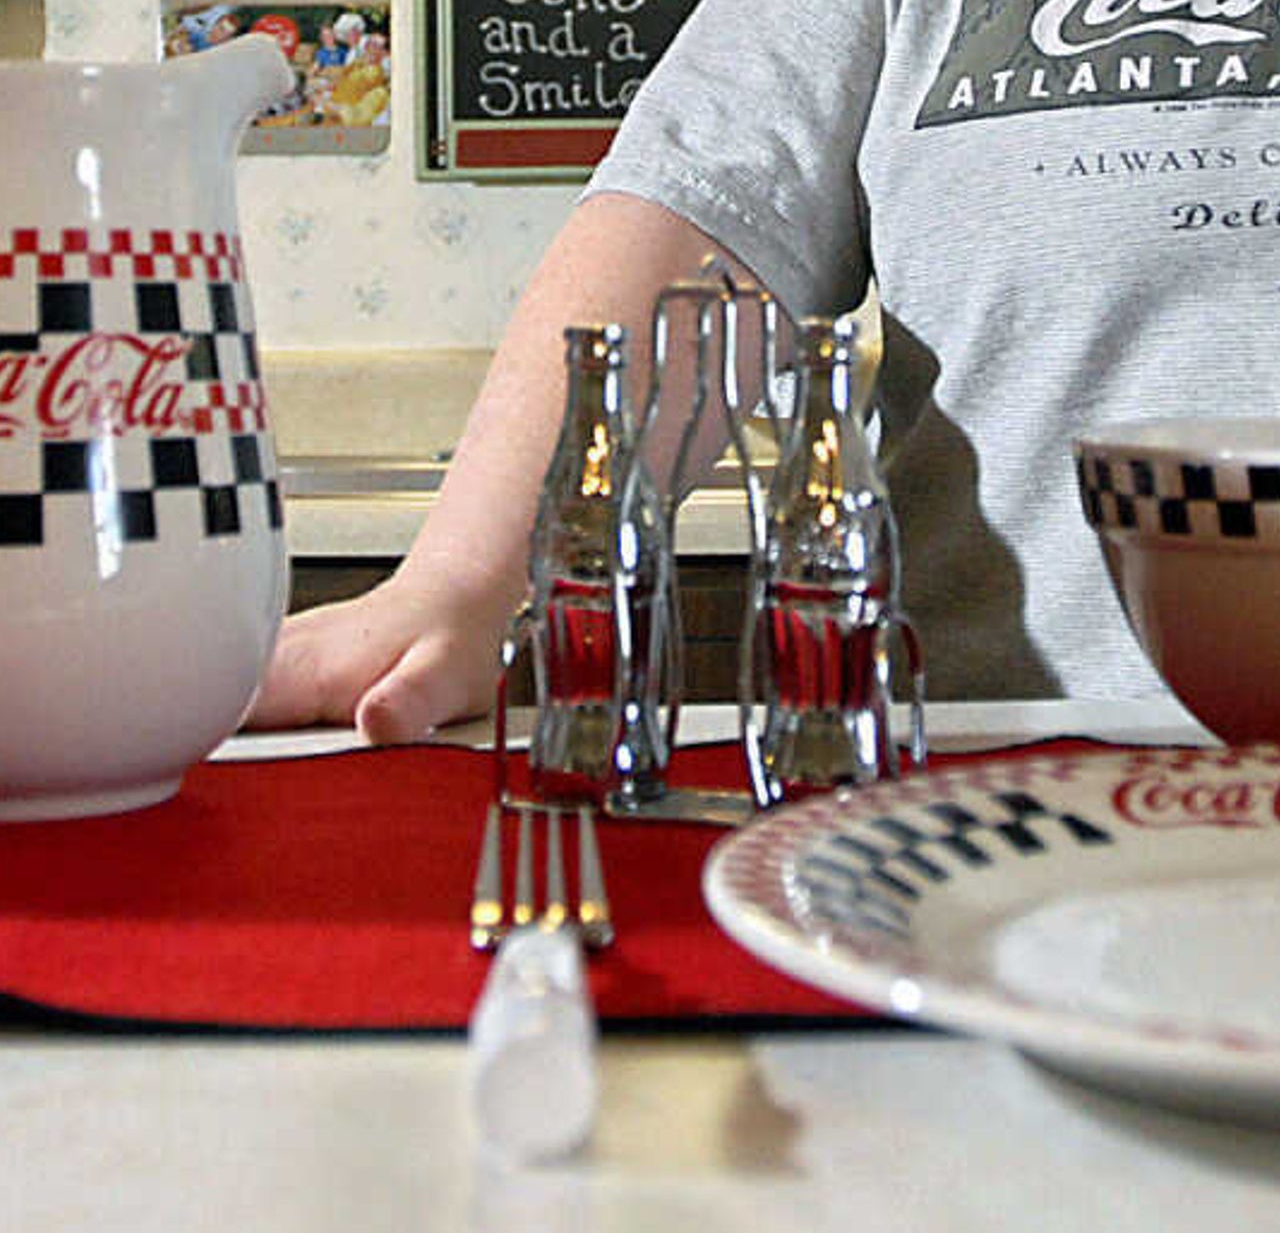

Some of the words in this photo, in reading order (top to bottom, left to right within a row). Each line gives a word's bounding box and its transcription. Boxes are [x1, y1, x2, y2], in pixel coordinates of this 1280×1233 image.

[480, 10, 590, 57] and
[608, 22, 646, 61] a
[1066, 146, 1237, 177] ALWAYS
